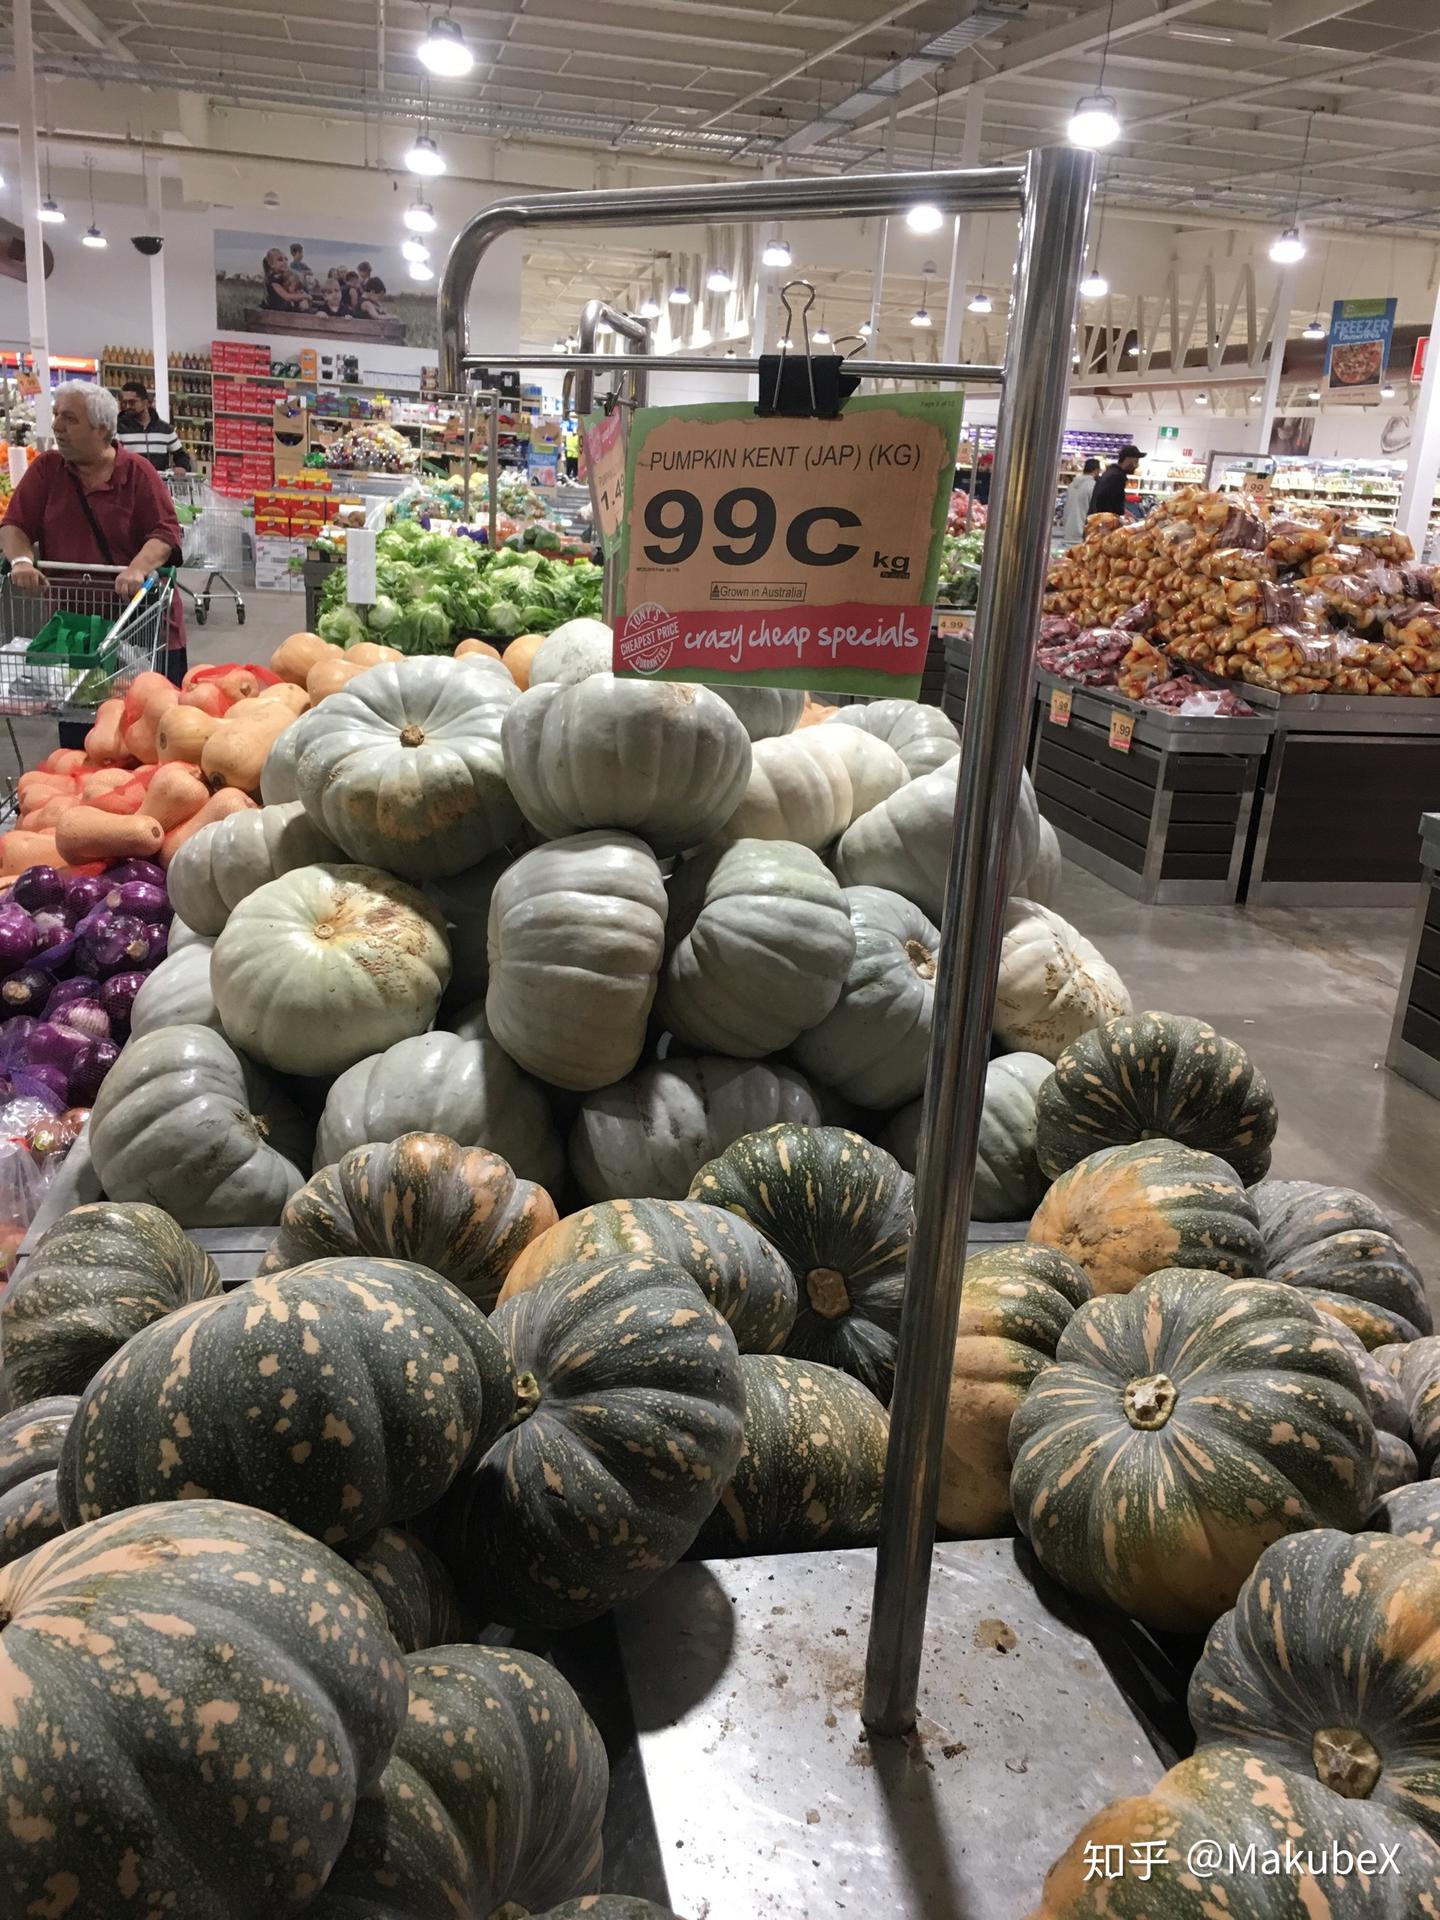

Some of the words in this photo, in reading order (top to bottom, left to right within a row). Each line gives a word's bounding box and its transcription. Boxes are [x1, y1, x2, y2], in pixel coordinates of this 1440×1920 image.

[1333, 318, 1390, 335] FREEZER
[650, 448, 737, 471] PUMPKIN
[742, 446, 800, 468] KENT
[805, 444, 862, 472] (JAP)
[868, 443, 921, 472] (KG)
[643, 487, 863, 567] 99c
[873, 551, 910, 573] kg
[720, 585, 750, 598] Grown
[751, 586, 760, 598] in
[761, 586, 803, 599] Australia
[629, 606, 662, 630] TONY'S
[620, 631, 655, 656] CHEAPEST
[656, 620, 680, 642] PRICE
[683, 623, 743, 664] crazy
[748, 618, 811, 659] cheap
[817, 611, 919, 659] specials
[635, 645, 668, 670] GUARANTEE
[1112, 722, 1131, 737] 1.99
